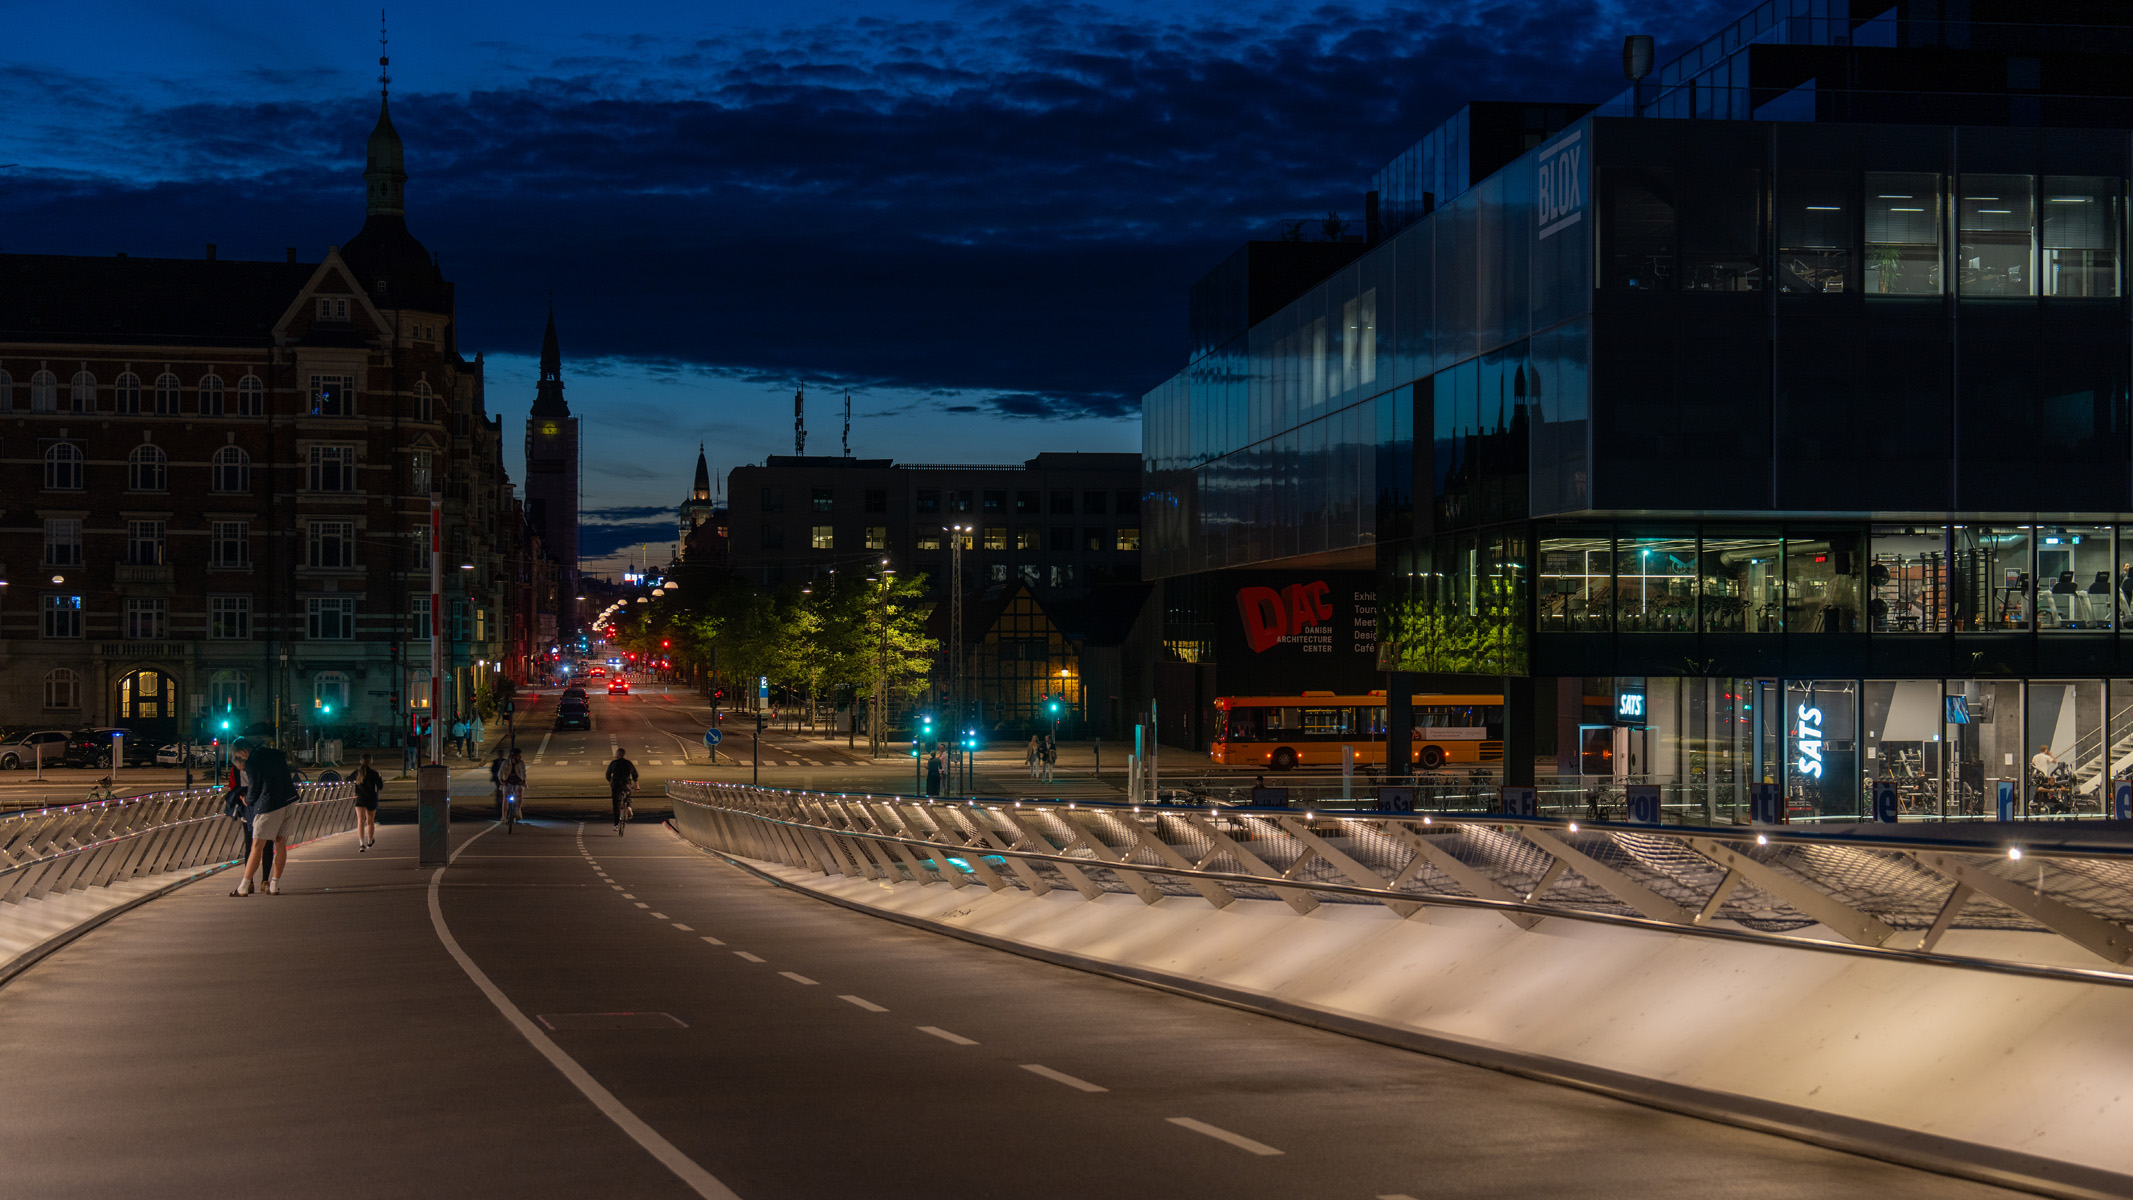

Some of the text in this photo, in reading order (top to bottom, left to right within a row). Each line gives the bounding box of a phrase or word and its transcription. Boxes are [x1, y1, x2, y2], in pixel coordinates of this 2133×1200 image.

[1539, 144, 1581, 227] BLOX
[1236, 580, 1333, 654] DAC
[1303, 645, 1332, 653] CENTER
[1354, 643, 1375, 653] Café
[1619, 694, 1642, 715] SATS
[1799, 704, 1822, 778] SATS
